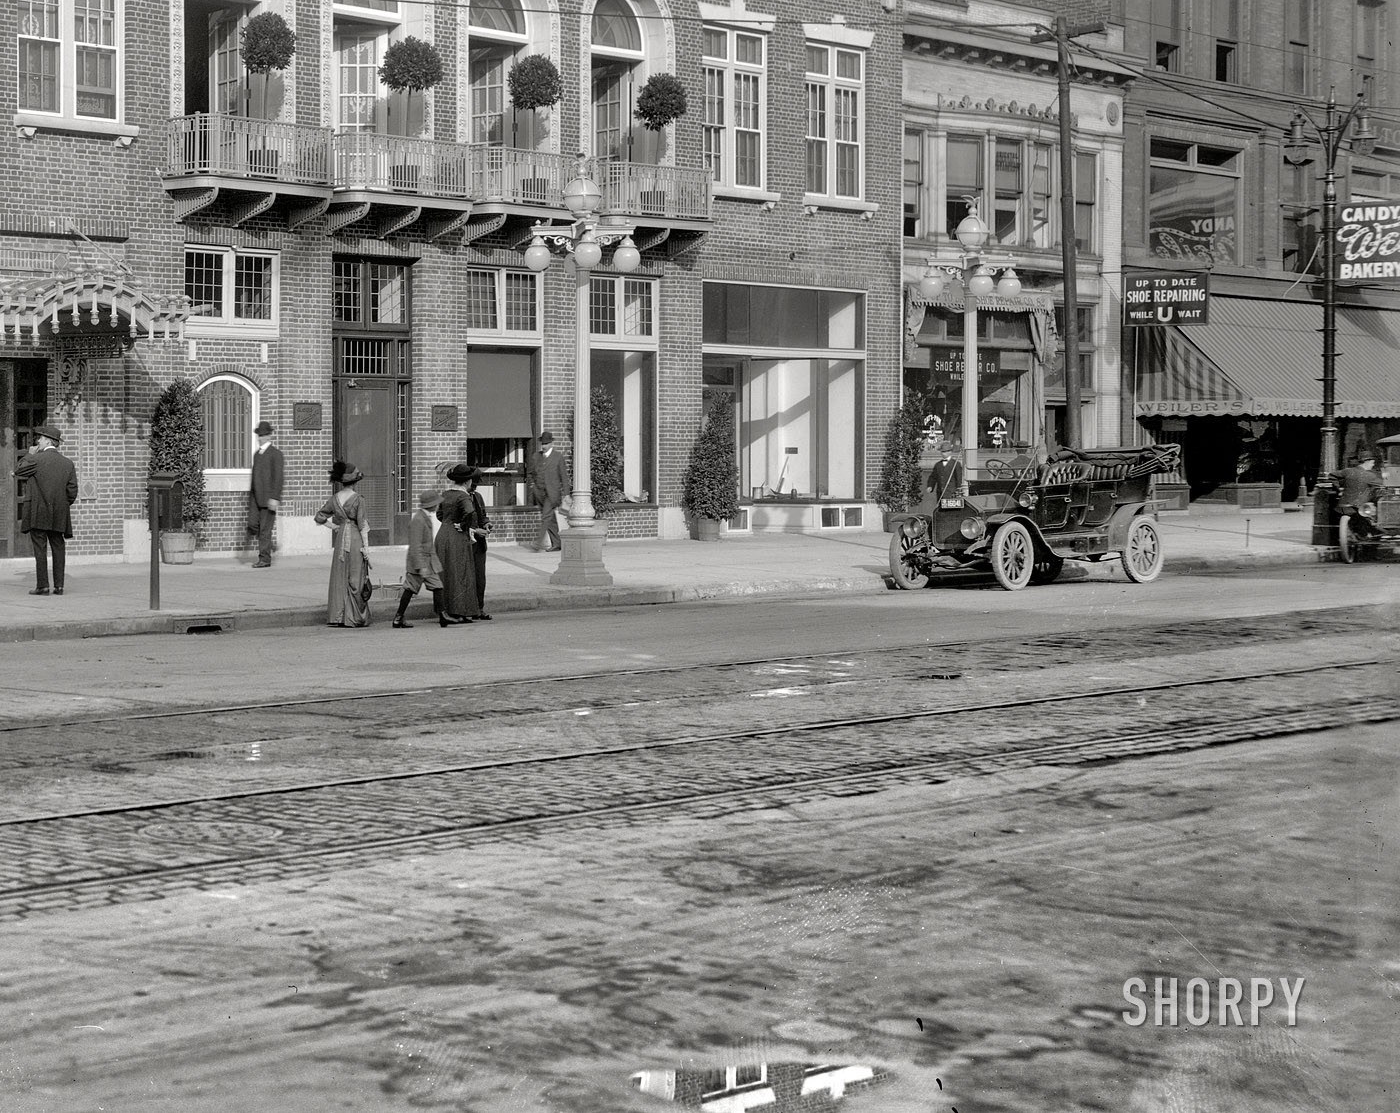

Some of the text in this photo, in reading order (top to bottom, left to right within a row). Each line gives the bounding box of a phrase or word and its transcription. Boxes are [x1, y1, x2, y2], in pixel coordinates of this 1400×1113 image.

[1154, 279, 1167, 287] TO
[1172, 278, 1197, 286] DATE
[1127, 289, 1205, 303] SHOE REPAIRING
[1130, 311, 1153, 319] WHILE
[1158, 307, 1173, 322] U
[935, 361, 953, 371] SHOE
[986, 362, 997, 373] CO.
[1138, 402, 1243, 412] WEILER'S
